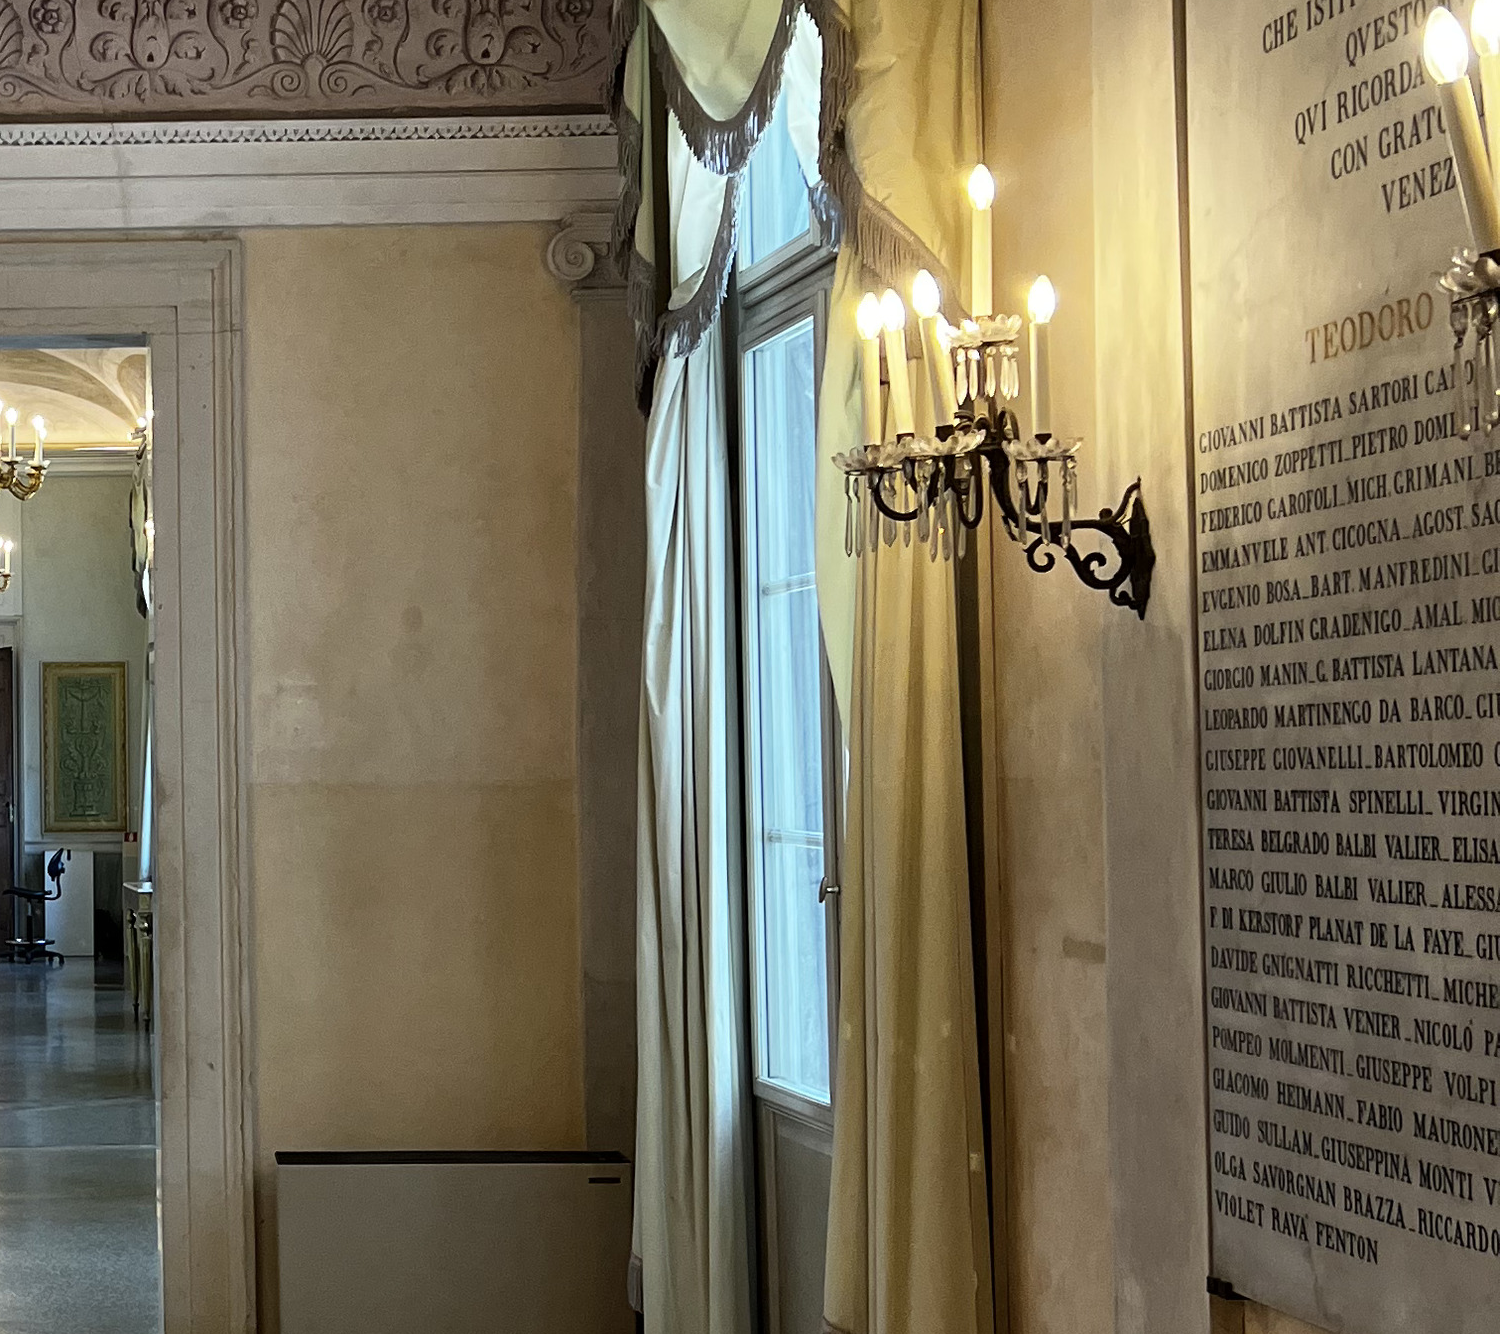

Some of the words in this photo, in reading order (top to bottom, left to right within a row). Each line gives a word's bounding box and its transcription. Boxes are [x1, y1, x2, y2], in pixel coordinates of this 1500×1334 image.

[1262, 8, 1298, 54] CHE
[1295, 100, 1327, 145] QVI
[1331, 135, 1368, 179] CON
[1381, 157, 1457, 213] VENEZ
[1306, 292, 1433, 365] TEODORO
[1199, 416, 1264, 454] GIOVANNI
[1270, 396, 1343, 437] BATTISTA
[1349, 374, 1419, 416] SARTORI
[1200, 458, 1268, 494] DOMENICO
[1352, 424, 1408, 460] PIETRO
[1201, 501, 1263, 534] FEDERICO
[1201, 537, 1288, 573] EMMANVELE
[1202, 583, 1260, 614] EVGENIO
[1203, 627, 1248, 652] ELENA
[1254, 618, 1304, 647] DOLFIN
[1204, 665, 1254, 691] GIORGIO
[1332, 653, 1405, 682] BATTISTA
[1412, 644, 1498, 676] LANTANA
[1205, 705, 1268, 731] LEOPARDO
[1274, 700, 1372, 728] MARTINENGO
[1379, 699, 1402, 724] DA
[1205, 747, 1267, 772] GIUSEPPE
[1374, 742, 1484, 769] BARTOLOMEO
[1206, 788, 1268, 813] GIOVANNI
[1273, 789, 1341, 814] BATTISTA
[1207, 828, 1255, 852] TERESA
[1260, 829, 1329, 856] BELGRADO
[1336, 832, 1377, 858] BALBI
[1209, 867, 1254, 892] MARCO
[1260, 871, 1308, 896] GIULIO
[1315, 874, 1359, 901] BALBI
[1222, 907, 1233, 930] DI
[1239, 908, 1303, 938] KERSTORF
[1309, 916, 1364, 945] PLANAT
[1369, 922, 1389, 948] DE
[1394, 924, 1416, 952] LA
[1211, 945, 1258, 974] DAVIDE
[1211, 986, 1267, 1017] GIOVANNI
[1273, 996, 1338, 1029] BATTISTA
[1212, 1025, 1262, 1058] POMPEO
[1356, 1054, 1433, 1093] GIUSEPPE
[1443, 1070, 1498, 1107] VOLPI
[1213, 1067, 1269, 1101] GIACOMO
[1356, 1099, 1403, 1133] FABIO
[1412, 1110, 1500, 1157] MAURONE
[1213, 1108, 1250, 1140] GUIDO
[1321, 1136, 1413, 1185] GIUSEPPINA
[1418, 1159, 1474, 1202] MONTI
[1214, 1150, 1247, 1182] OLGA
[1253, 1161, 1337, 1208] SAVORGNAN
[1215, 1189, 1265, 1228] VIOLET
[1316, 1220, 1379, 1265] FENTON
